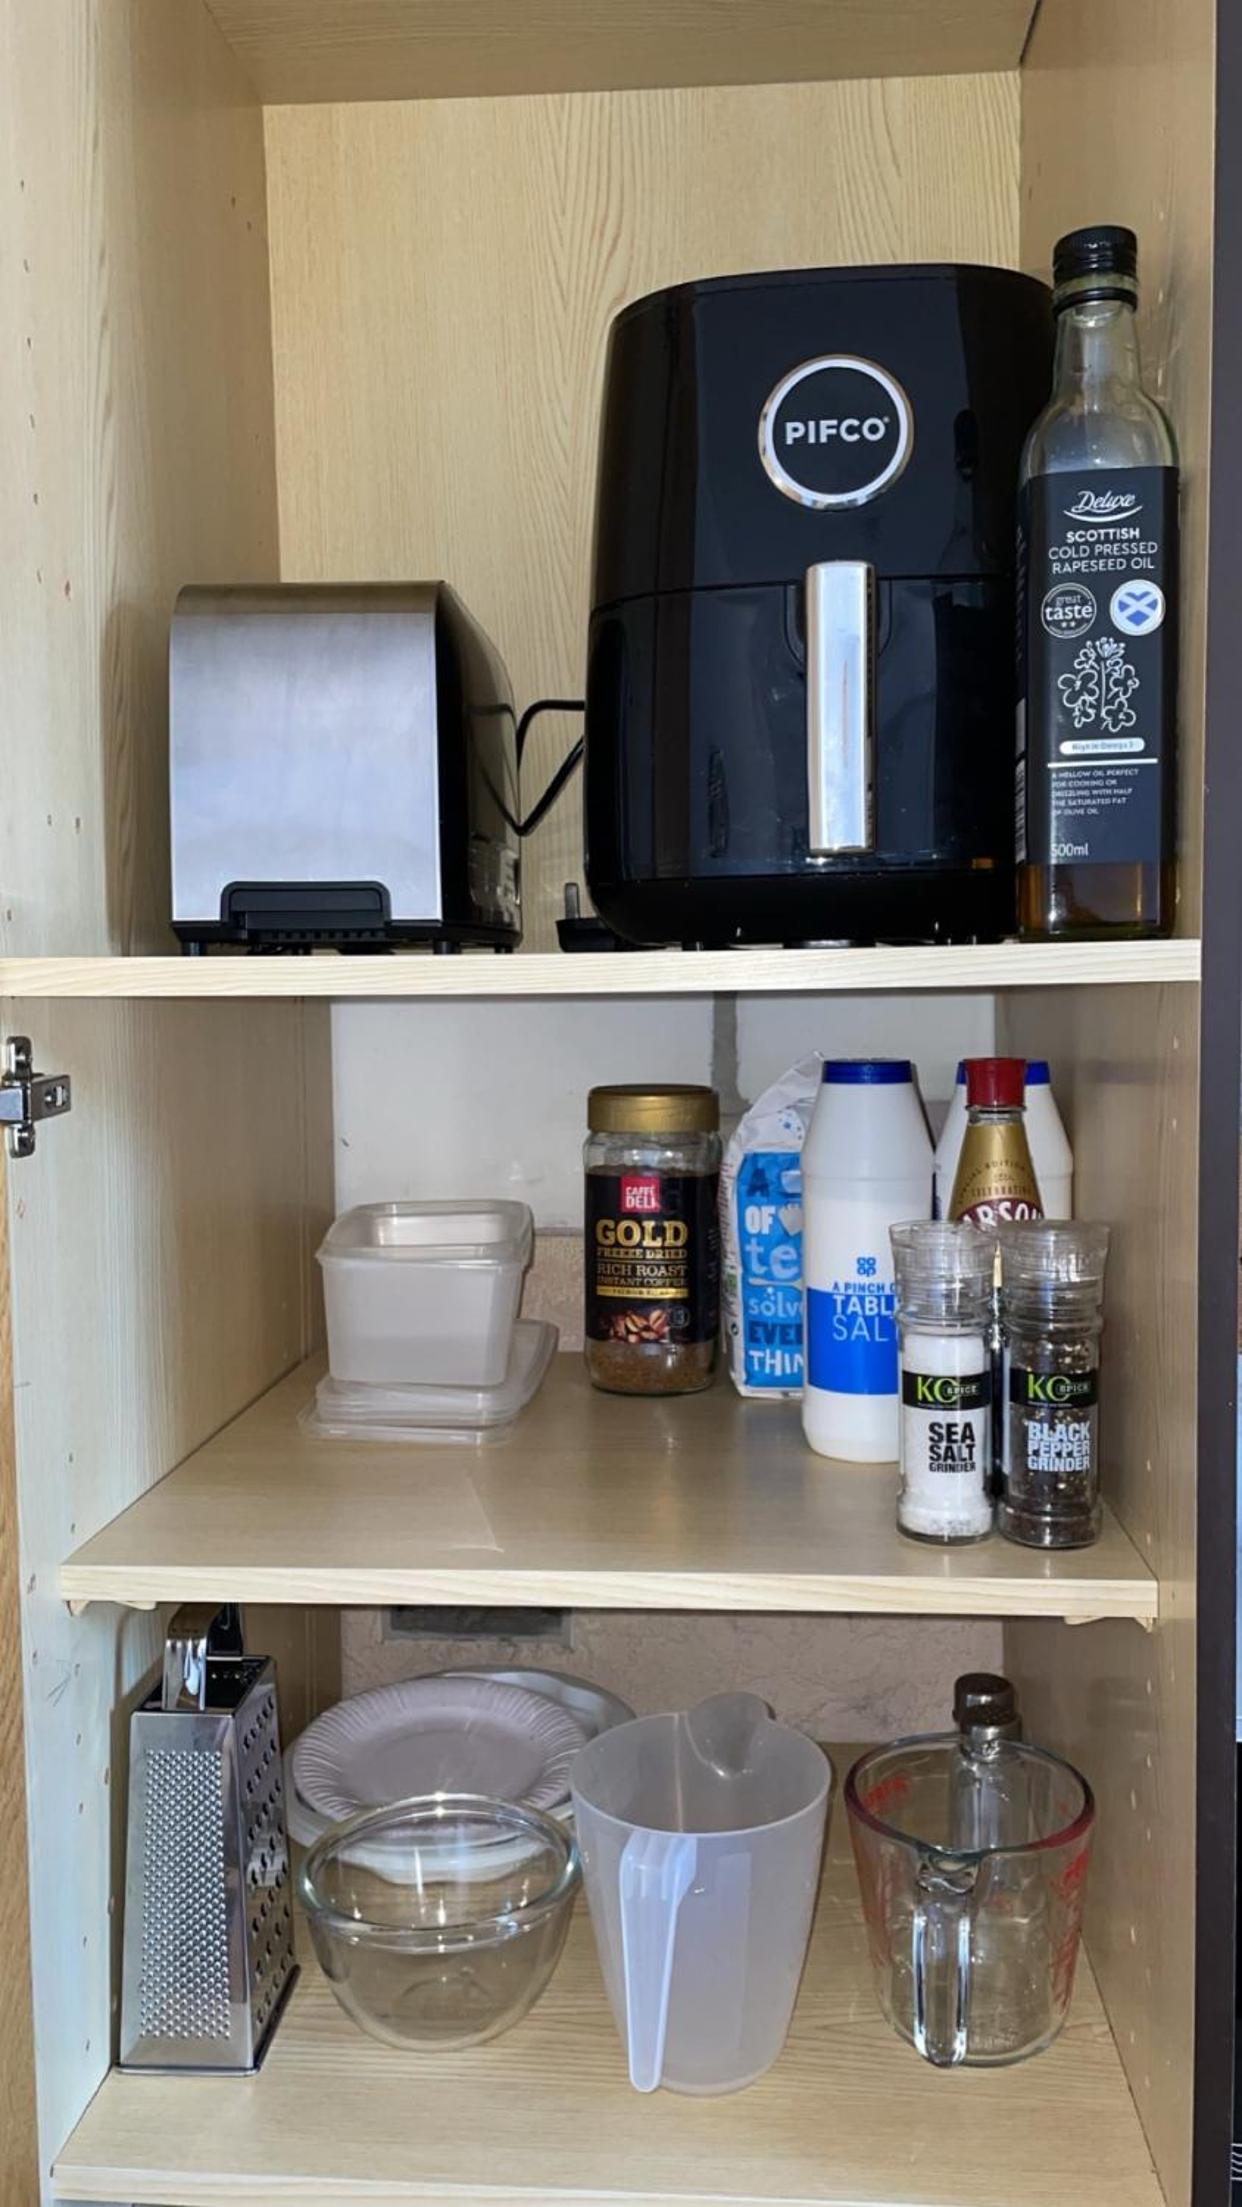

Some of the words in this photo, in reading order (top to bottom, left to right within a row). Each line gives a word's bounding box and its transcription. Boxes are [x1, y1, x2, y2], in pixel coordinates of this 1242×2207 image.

[1071, 490, 1136, 513] Deluxe
[1066, 527, 1140, 543] SCOTTISH
[1048, 545, 1090, 560] COLD
[1094, 541, 1158, 556] PRESSED
[1052, 559, 1127, 574] RAPESEED
[1131, 557, 1155, 570] OIL
[1045, 605, 1093, 621] taste
[1106, 769, 1139, 777] PERFECT
[1068, 798, 1111, 806] SATURATED
[1051, 843, 1089, 857] 500ml
[746, 1167, 770, 1197] A
[745, 1205, 777, 1235] OF
[596, 1219, 689, 1247] GOLD
[597, 1247, 644, 1258] FREEZE
[645, 1248, 688, 1259] DRIED
[746, 1238, 800, 1279] te
[597, 1263, 632, 1276] RICH
[636, 1264, 688, 1276] ROAST
[597, 1277, 642, 1287] INSTANT
[643, 1278, 688, 1287] COFFEE
[832, 1281, 840, 1292] A
[845, 1282, 885, 1293] PINCH
[748, 1291, 803, 1318] solv
[748, 1321, 803, 1346] EVE
[928, 1422, 976, 1444] SEA
[1028, 1420, 1090, 1441] BLACK
[929, 1444, 976, 1462] SALT
[1028, 1441, 1090, 1457] PEPPER
[929, 1462, 976, 1473] GRINDER
[1027, 1456, 1090, 1472] GRINDER
